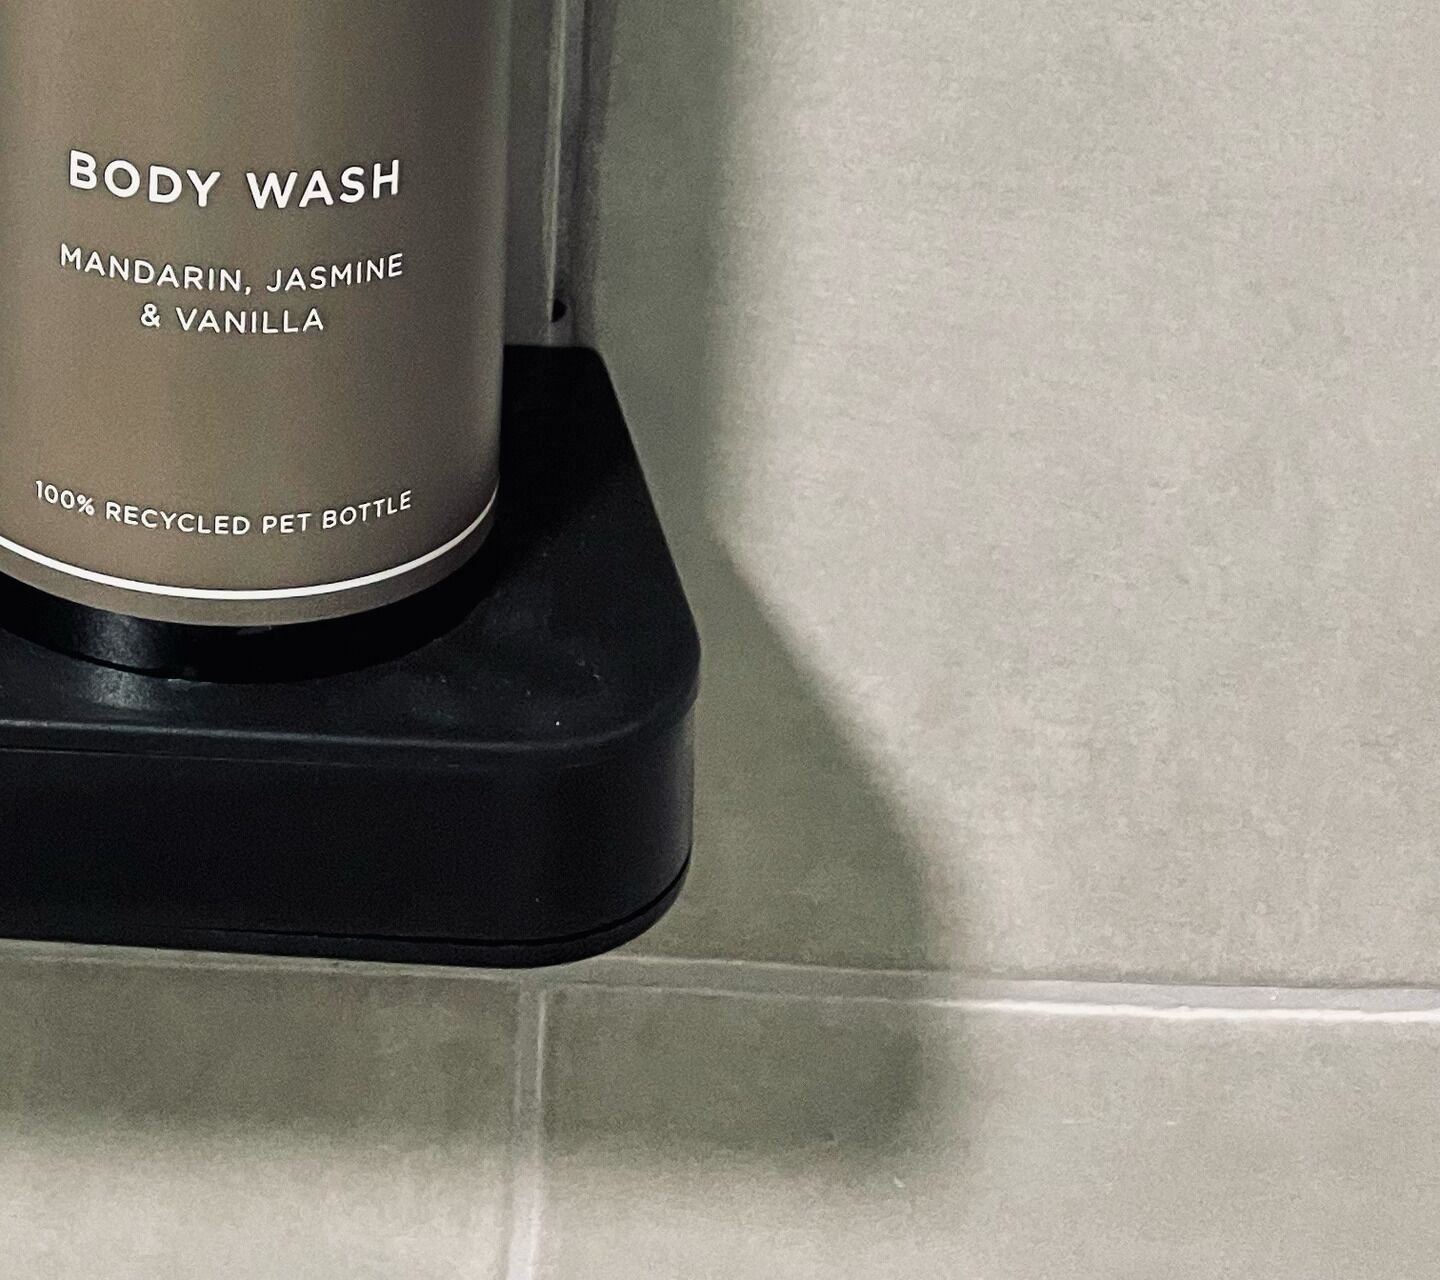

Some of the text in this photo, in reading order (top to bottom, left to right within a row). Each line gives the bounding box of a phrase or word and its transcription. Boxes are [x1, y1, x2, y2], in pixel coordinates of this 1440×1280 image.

[69, 149, 401, 210] BODY WASH
[60, 243, 404, 296] MANDARIN, JASMINE
[140, 303, 324, 334] & VANILLA
[35, 480, 412, 536] 100% RECYCLED PET BOTTLE
